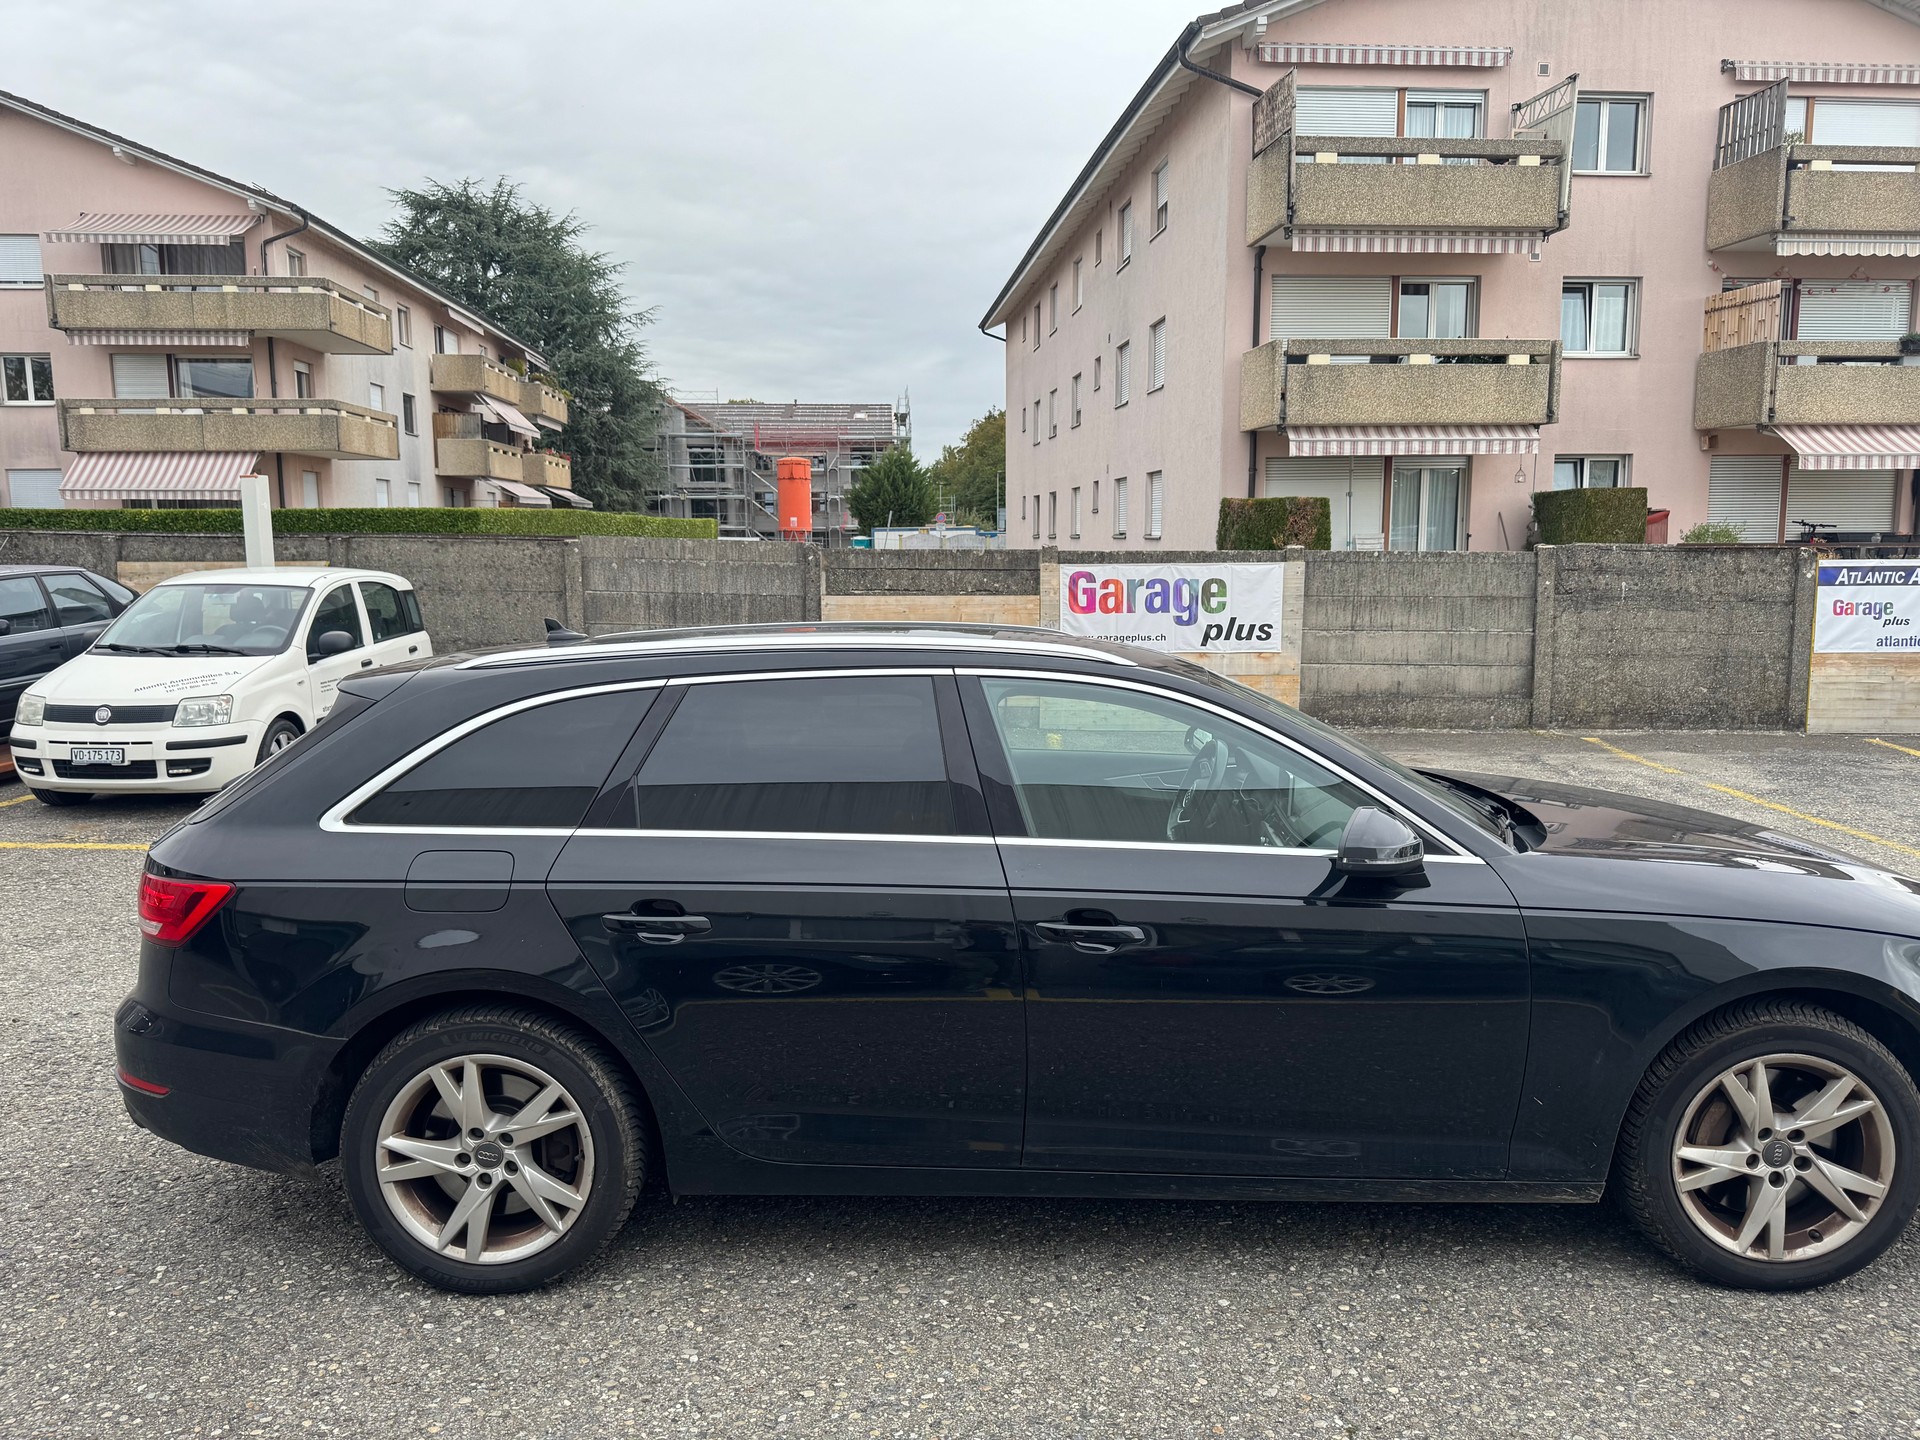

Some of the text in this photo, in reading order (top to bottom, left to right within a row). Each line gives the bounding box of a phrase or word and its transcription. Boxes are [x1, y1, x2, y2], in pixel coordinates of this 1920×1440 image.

[1835, 568, 1905, 585] ATLANTIC
[1068, 570, 1227, 626] Garage
[1833, 599, 1894, 620] Garage
[1200, 617, 1274, 646] plus
[1882, 616, 1910, 628] plus
